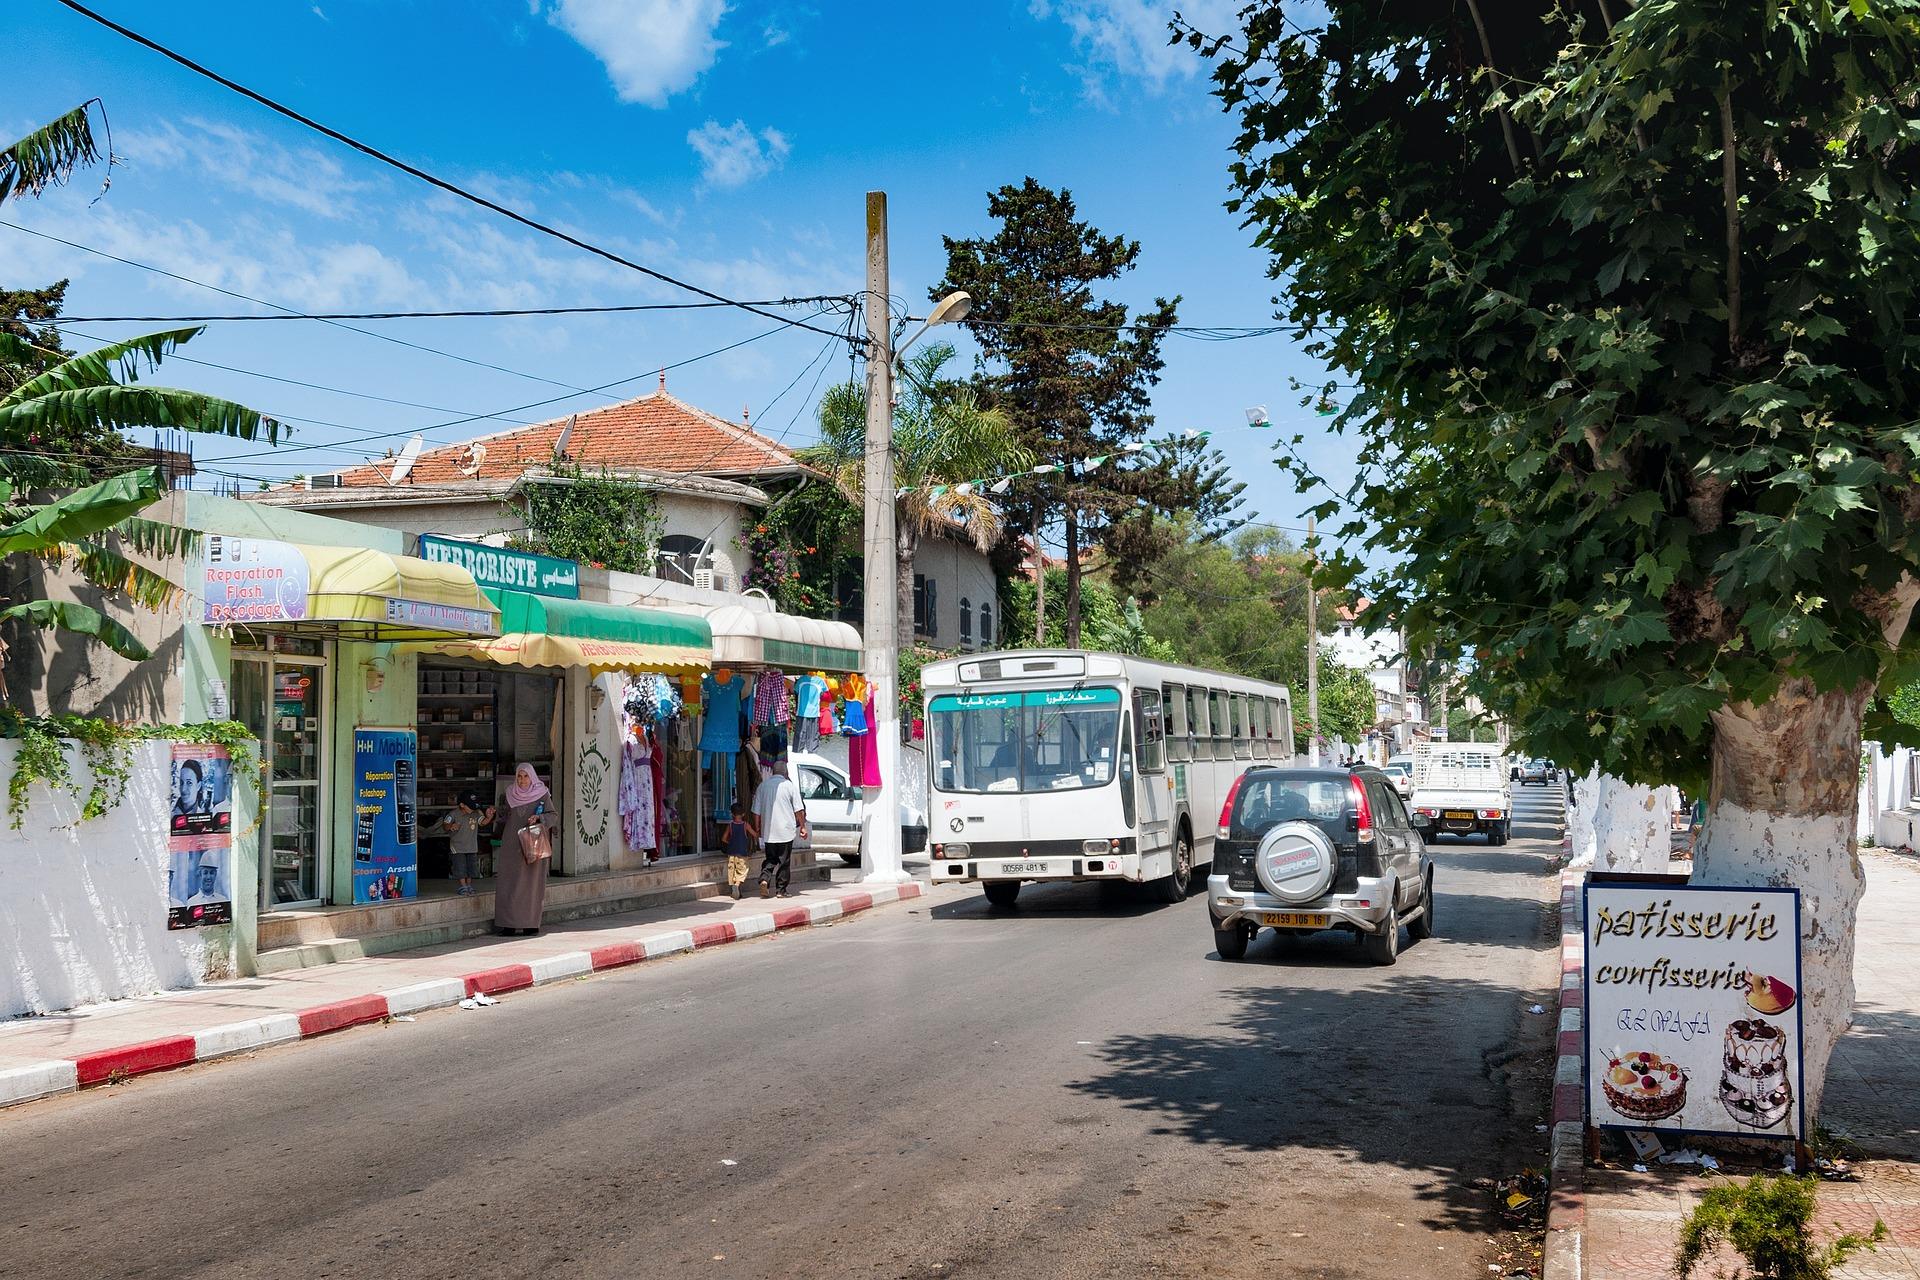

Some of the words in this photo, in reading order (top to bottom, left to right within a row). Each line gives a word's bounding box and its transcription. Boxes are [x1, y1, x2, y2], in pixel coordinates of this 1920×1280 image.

[226, 585, 262, 600] Flash
[378, 738, 415, 756] Mobile
[576, 809, 609, 847] HERBORISTE
[1271, 856, 1318, 876] TERIOS
[1267, 914, 1290, 924] 22159
[1294, 914, 1309, 925] 106
[1313, 915, 1323, 925] 16
[1595, 899, 1779, 947] patisserie
[1595, 957, 1751, 994] confisserie
